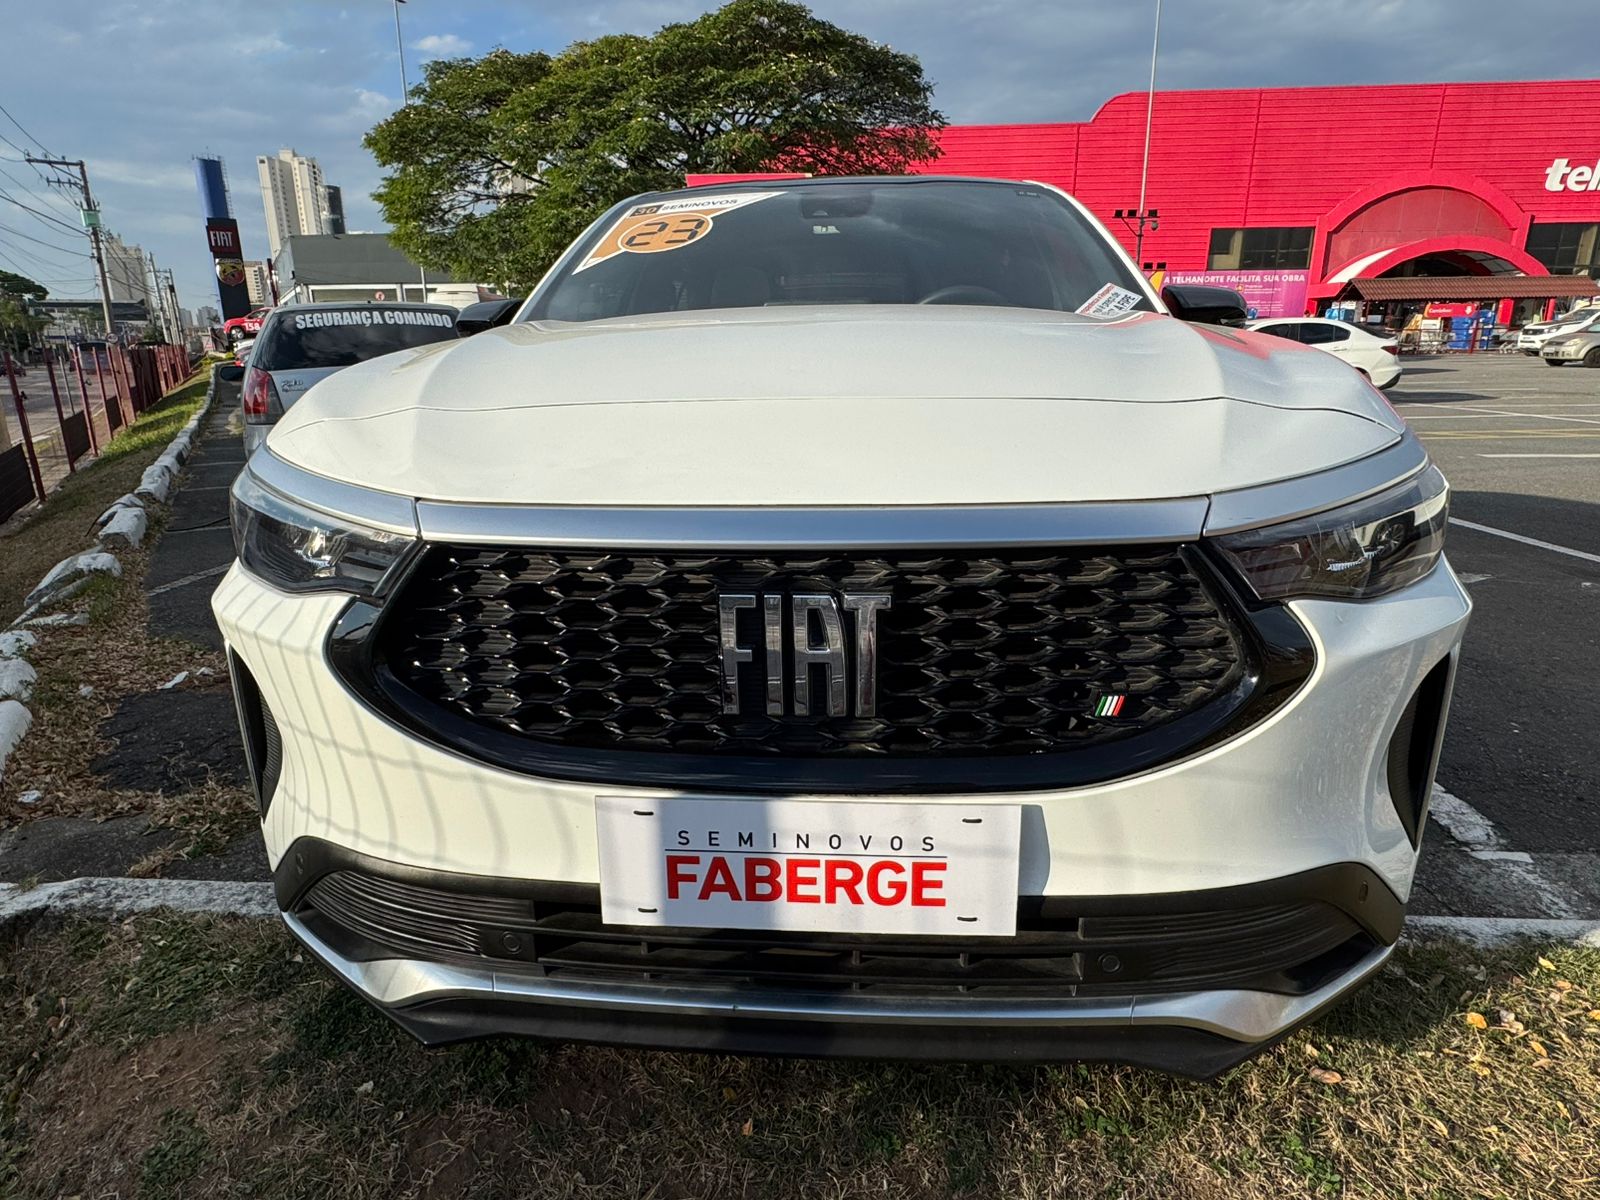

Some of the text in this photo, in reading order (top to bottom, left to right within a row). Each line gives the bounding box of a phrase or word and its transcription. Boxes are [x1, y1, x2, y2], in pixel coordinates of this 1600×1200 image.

[1545, 158, 1600, 192] tel
[662, 199, 738, 210] SEMINOVOS
[210, 231, 233, 247] FIAT
[625, 218, 705, 247] 23
[1171, 275, 1225, 284] TELHANORTE
[1226, 275, 1261, 283] FACILITA
[1281, 274, 1305, 282] OBRA
[296, 311, 453, 330] SEGURANÇA COMANDO
[719, 594, 892, 718] FIAT
[677, 830, 936, 852] SEMINOVOS
[665, 855, 948, 907] FABERGE
